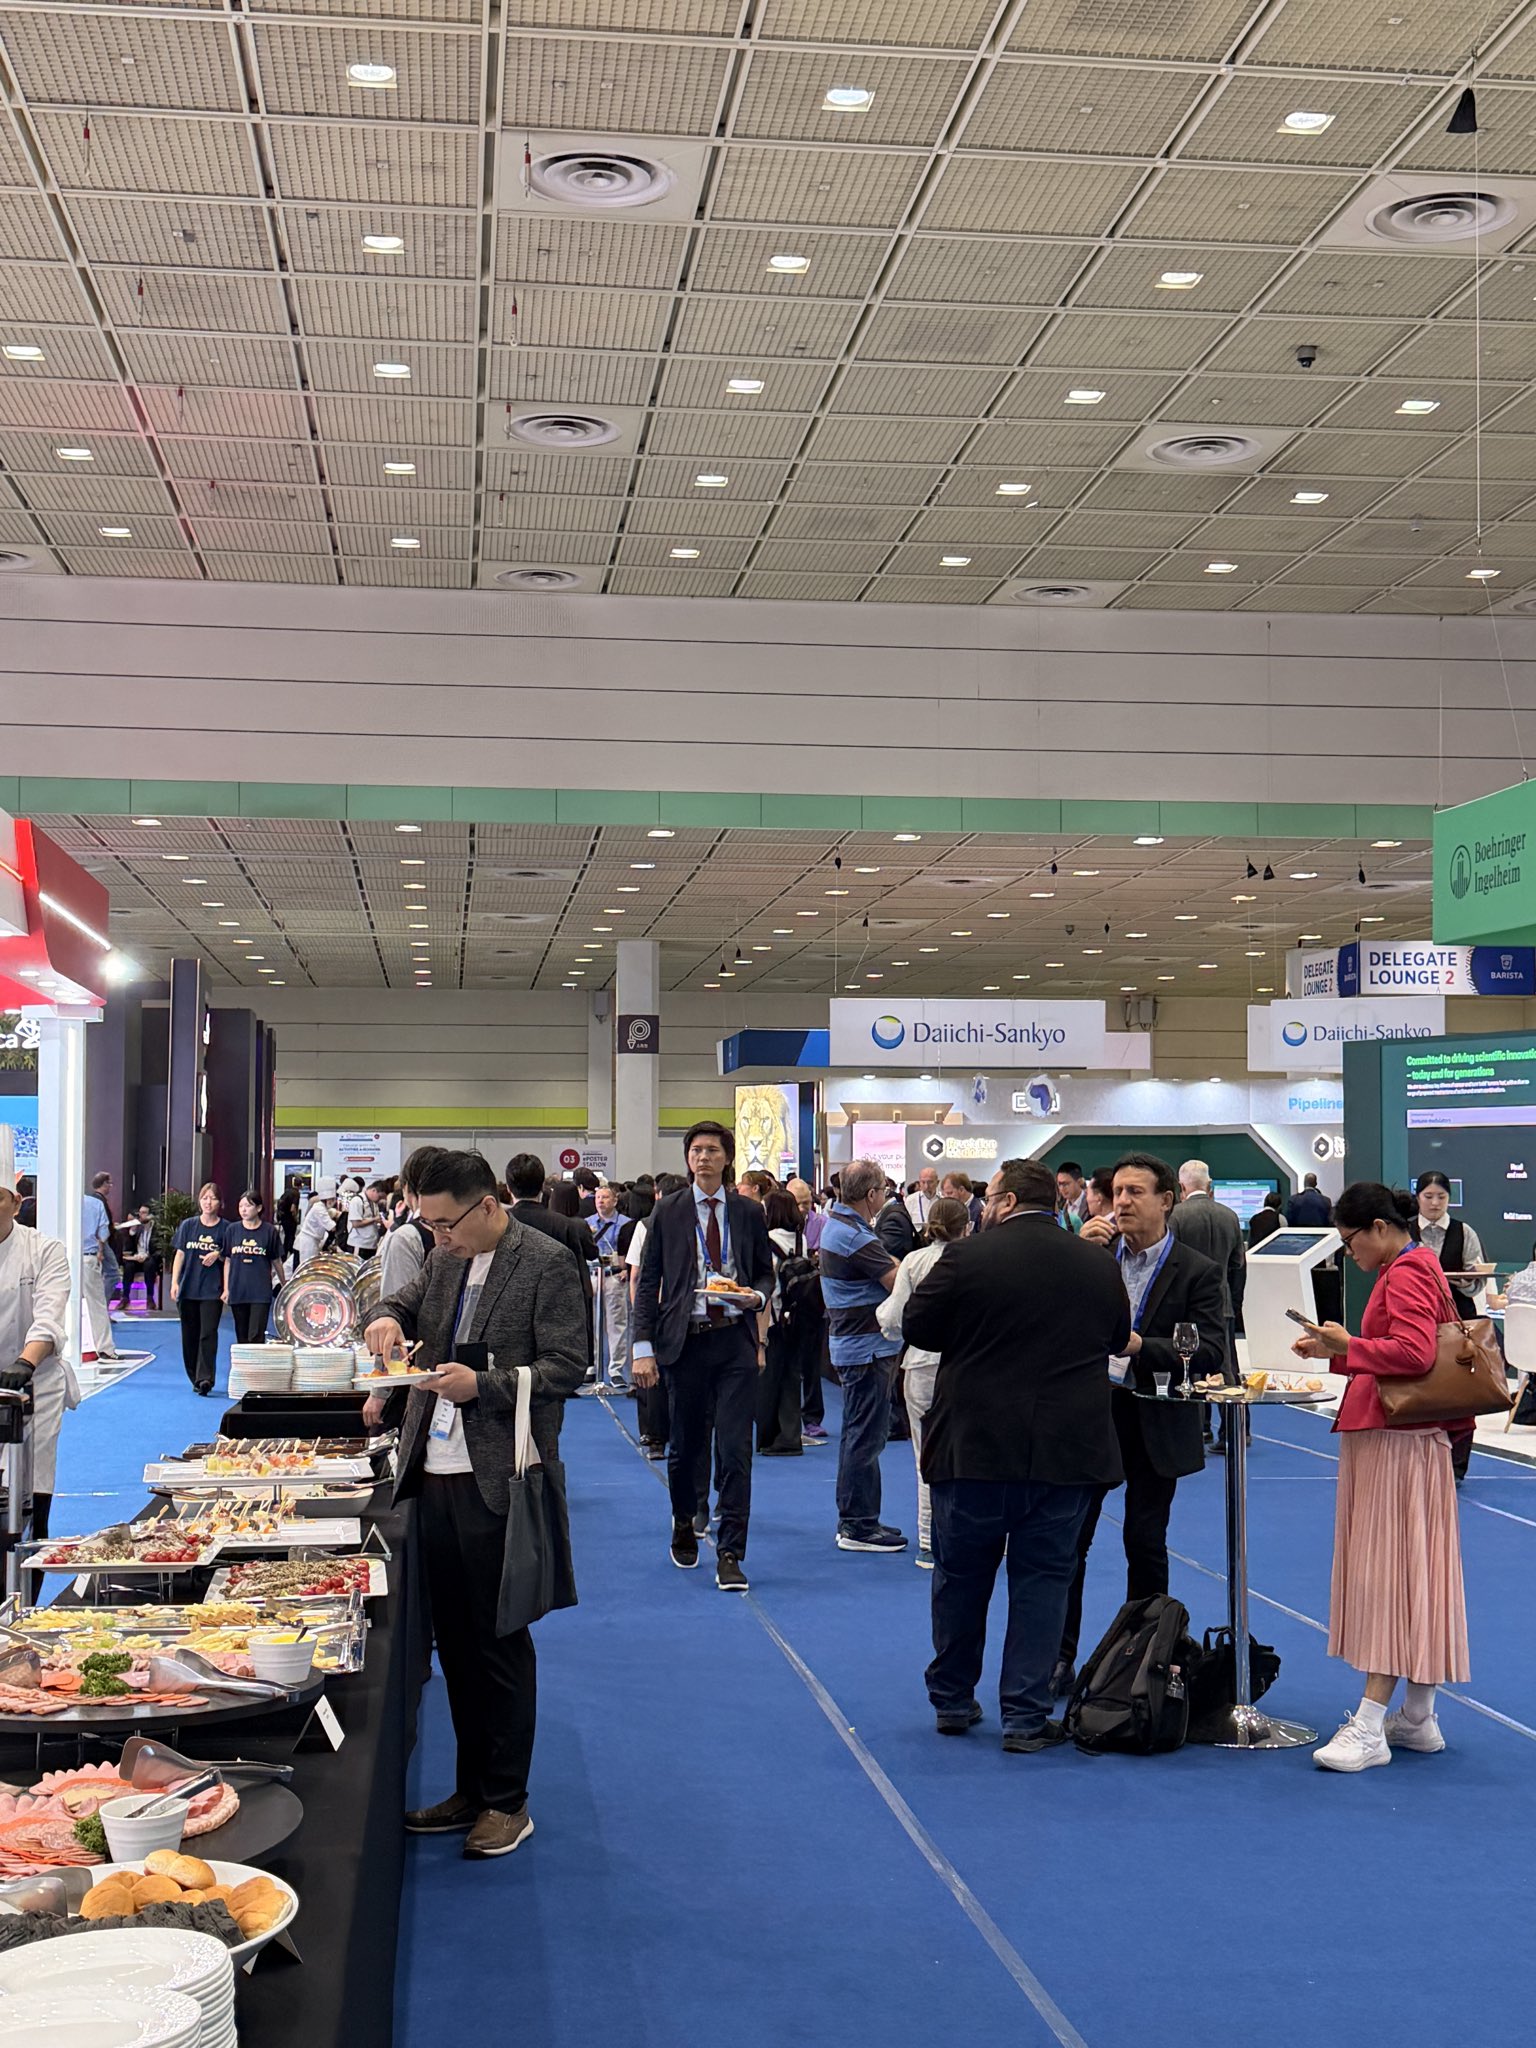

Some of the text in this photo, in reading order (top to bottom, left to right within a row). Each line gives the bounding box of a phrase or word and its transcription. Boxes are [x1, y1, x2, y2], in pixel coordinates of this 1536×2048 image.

[1475, 833, 1526, 864] Boehringer
[1474, 862, 1521, 895] Ingelheim
[1370, 951, 1458, 967] DELEGATE
[1303, 959, 1334, 980] DELEGATE
[1490, 971, 1524, 980] BARISTA
[1369, 970, 1455, 986] LOUNGE 2
[1303, 977, 1334, 997] LOUNGE 2
[913, 1021, 1066, 1051] Daiichi-Sankyo
[1406, 1054, 1443, 1066] Committed
[1444, 1054, 1451, 1064] to
[1452, 1052, 1475, 1065] driving
[1475, 1050, 1506, 1063] scientific
[1412, 1069, 1431, 1081] today
[1431, 1068, 1444, 1079] and
[1444, 1068, 1454, 1078] for
[1455, 1066, 1495, 1080] generations
[1288, 1097, 1344, 1112] Pipeline
[563, 1155, 576, 1163] 03
